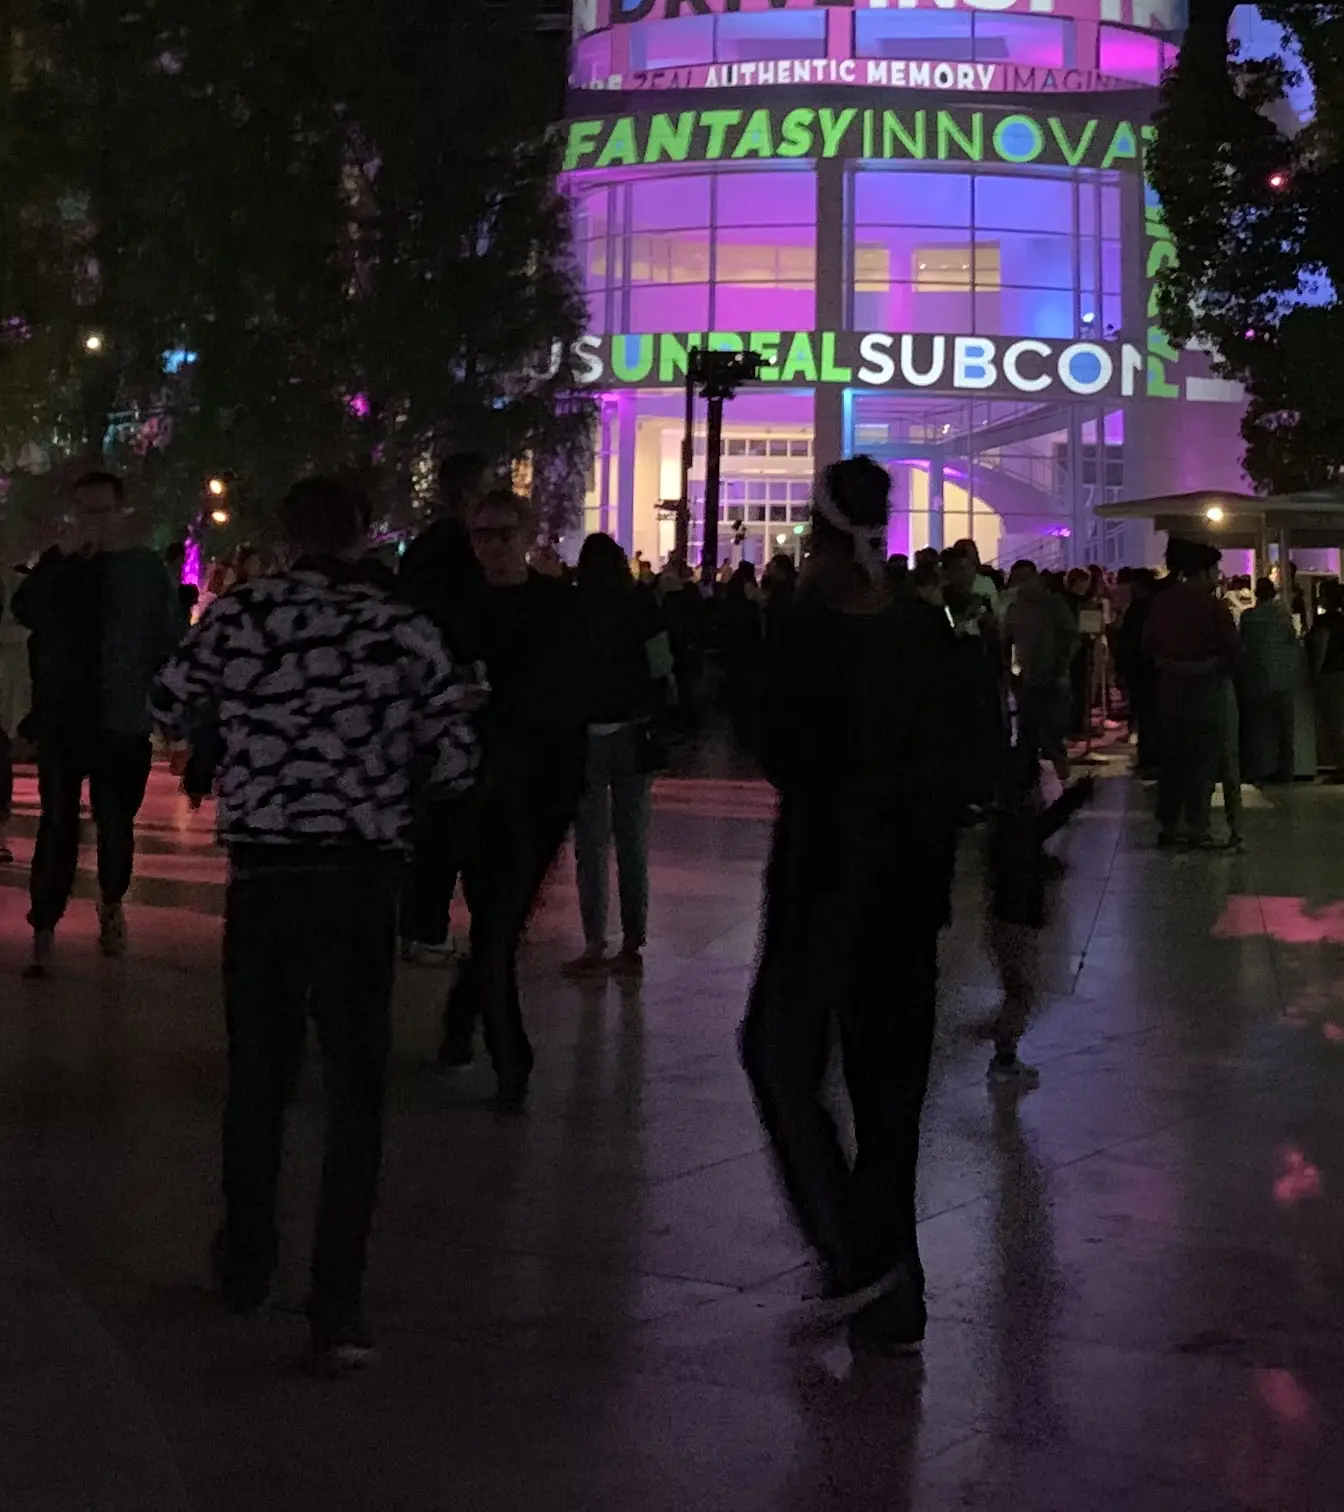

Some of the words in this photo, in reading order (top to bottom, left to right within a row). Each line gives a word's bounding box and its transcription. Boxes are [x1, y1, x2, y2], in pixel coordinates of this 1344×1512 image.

[705, 59, 856, 88] AUTHENTIC
[867, 59, 996, 90] MEMORY
[562, 108, 858, 171] FANTASY
[863, 109, 1137, 169] INNOVA
